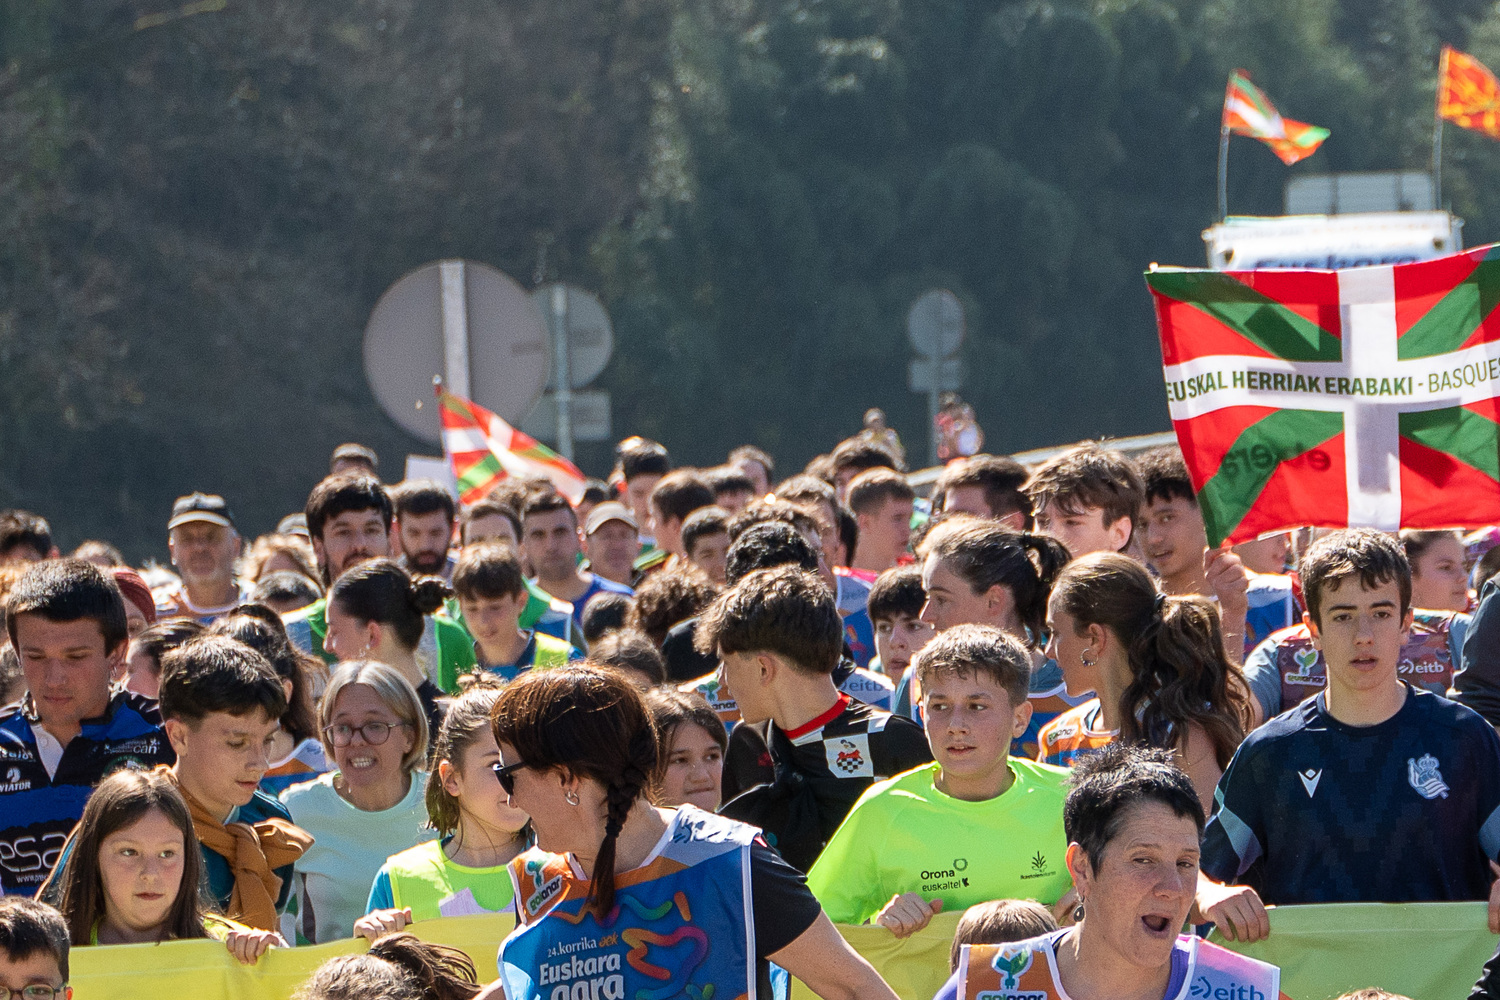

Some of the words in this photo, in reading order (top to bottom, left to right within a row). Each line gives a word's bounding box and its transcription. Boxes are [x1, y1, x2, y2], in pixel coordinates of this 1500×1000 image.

[1166, 370, 1228, 403] EUSKAL
[1232, 370, 1321, 395] HERRIAK
[1325, 376, 1413, 396] ERABAKI
[1415, 662, 1444, 673] eitb
[920, 869, 955, 880] Orona
[922, 880, 961, 892] euskaltel
[547, 937, 597, 958] 24.korrika
[539, 953, 622, 986] Euskara
